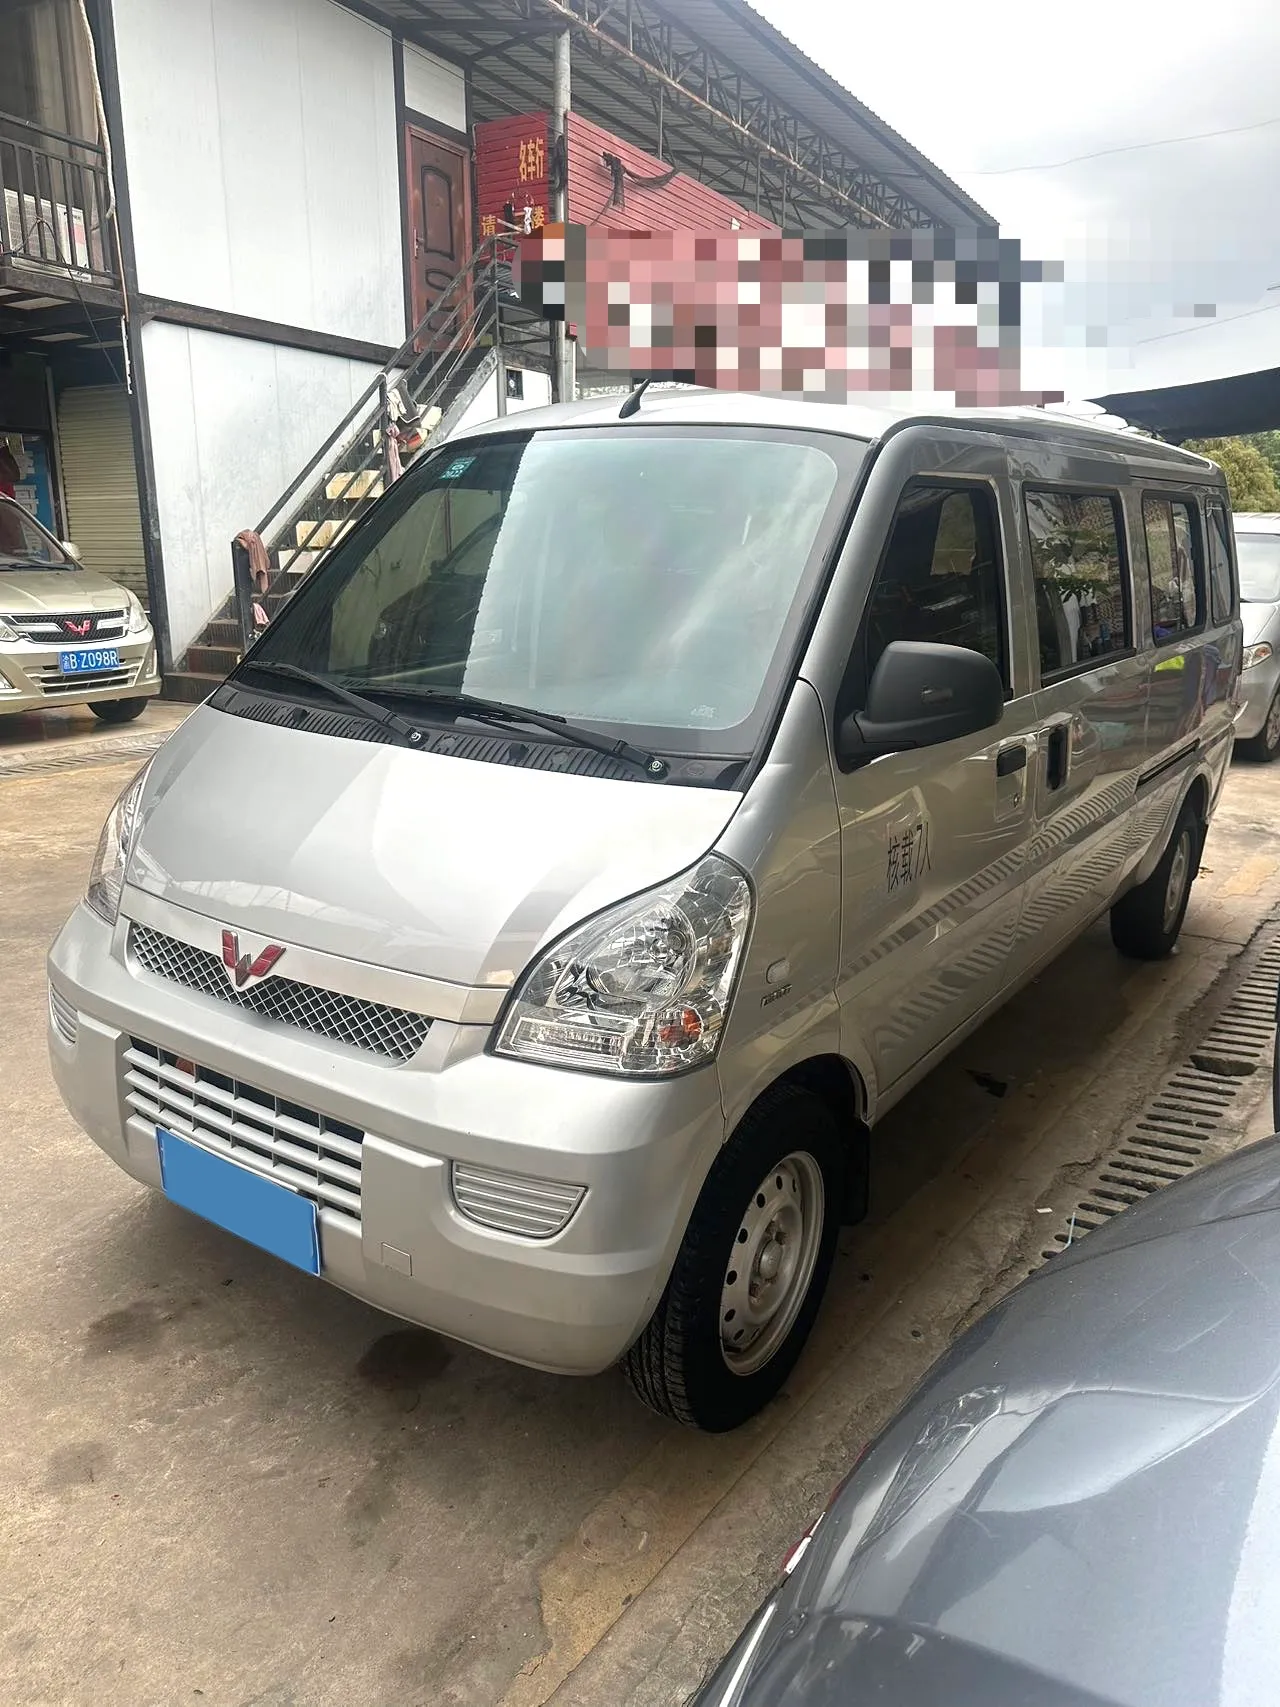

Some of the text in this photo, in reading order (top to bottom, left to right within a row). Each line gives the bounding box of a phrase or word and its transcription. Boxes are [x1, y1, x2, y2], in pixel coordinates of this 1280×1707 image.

[519, 137, 545, 182] 名车行
[886, 822, 931, 894] 核载7人
